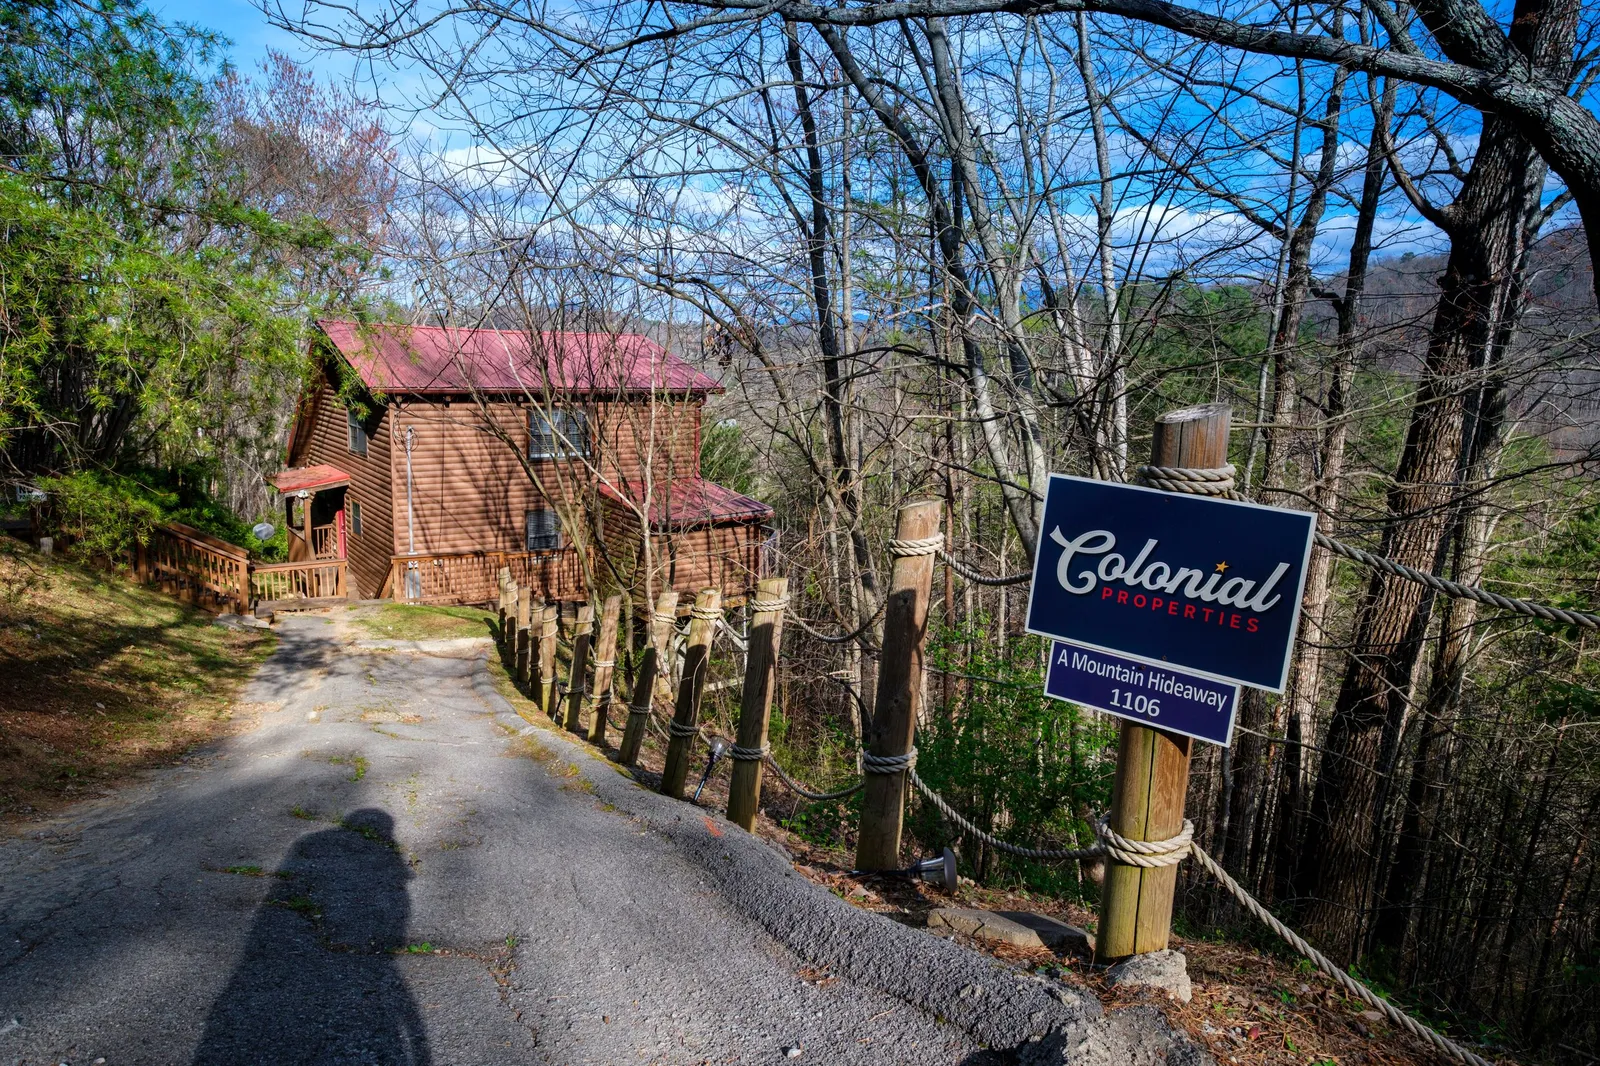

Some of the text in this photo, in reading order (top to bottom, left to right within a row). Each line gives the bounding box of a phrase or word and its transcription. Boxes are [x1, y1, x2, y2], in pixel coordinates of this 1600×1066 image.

[1049, 525, 1290, 612] Colonial
[1102, 587, 1259, 632] PROPERTIES
[1057, 649, 1227, 712] A Mountain Hideaway
[1109, 688, 1161, 717] 1106
